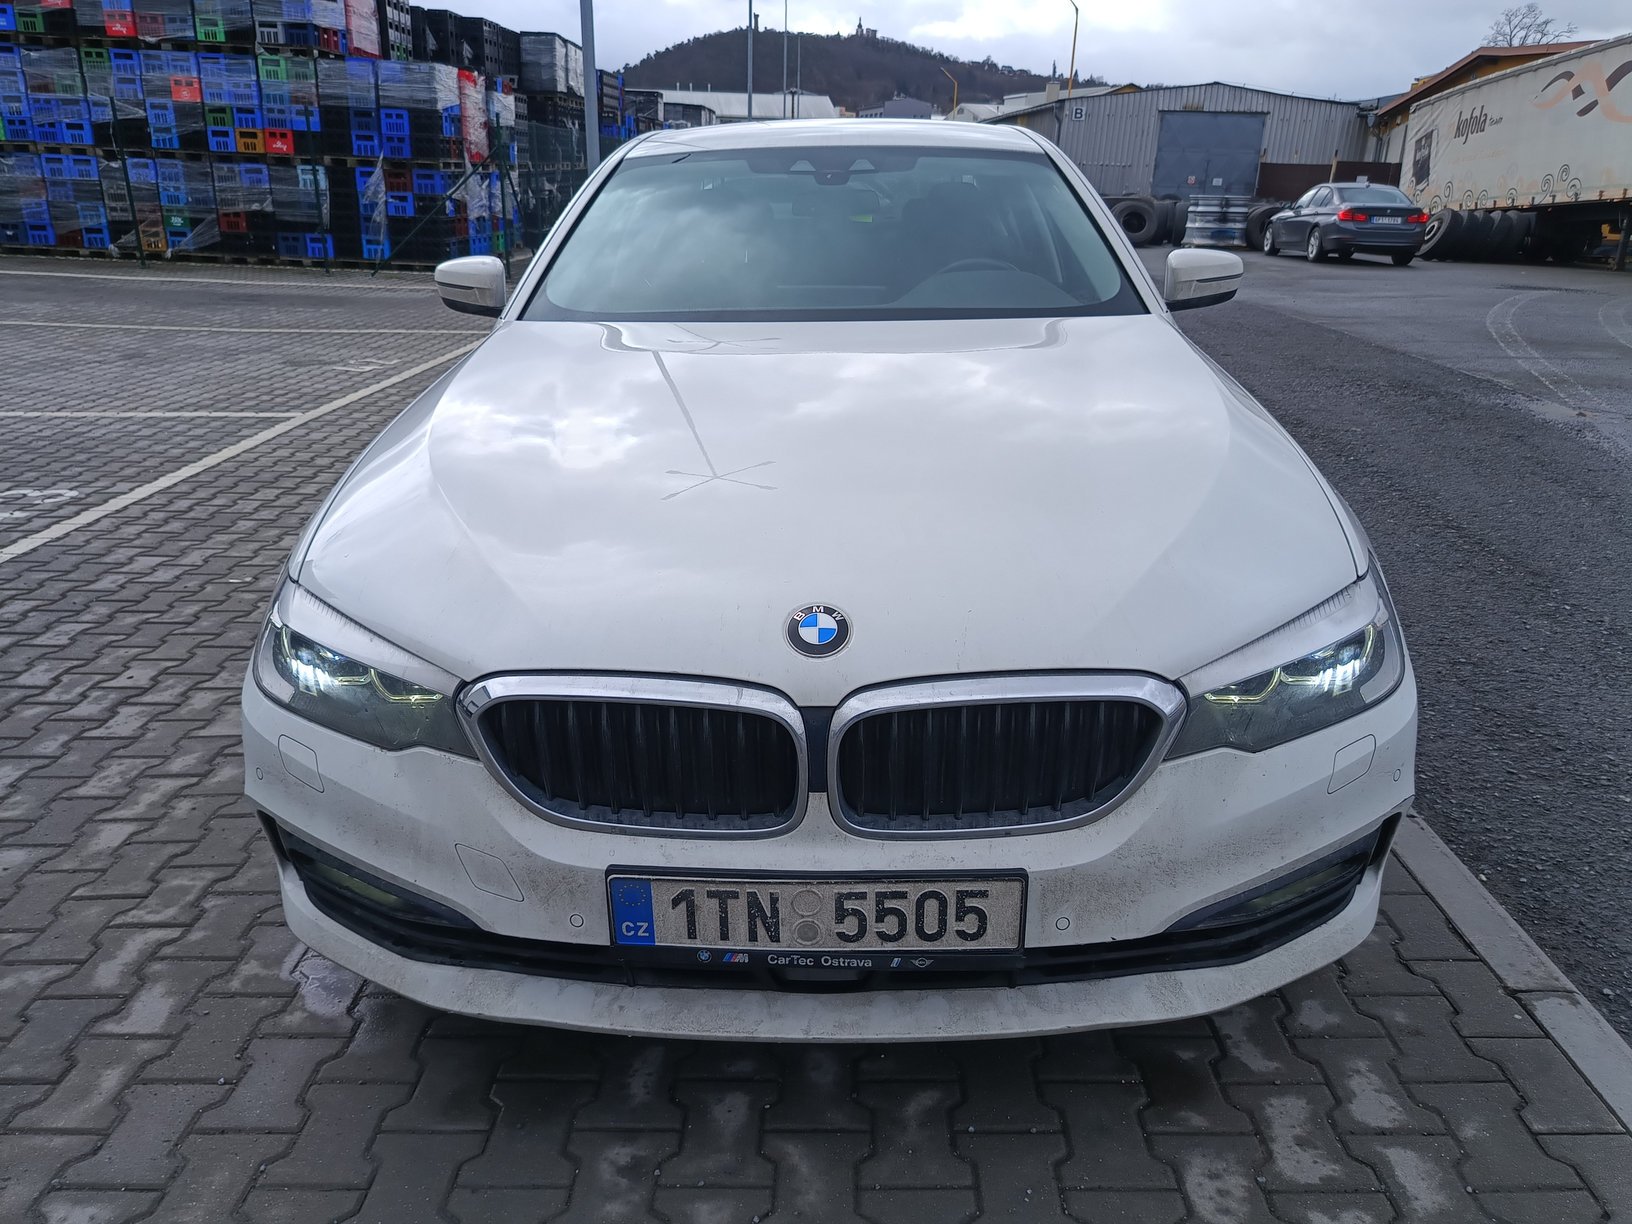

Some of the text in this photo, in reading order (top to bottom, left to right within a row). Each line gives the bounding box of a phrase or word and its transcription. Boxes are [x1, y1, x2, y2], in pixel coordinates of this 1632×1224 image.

[1074, 107, 1083, 119] B
[1453, 104, 1488, 145] kofola
[793, 605, 845, 621] BMW
[671, 888, 990, 943] 1TN 5505
[621, 922, 650, 937] CZ
[767, 954, 872, 967] CarTec Ostrava
